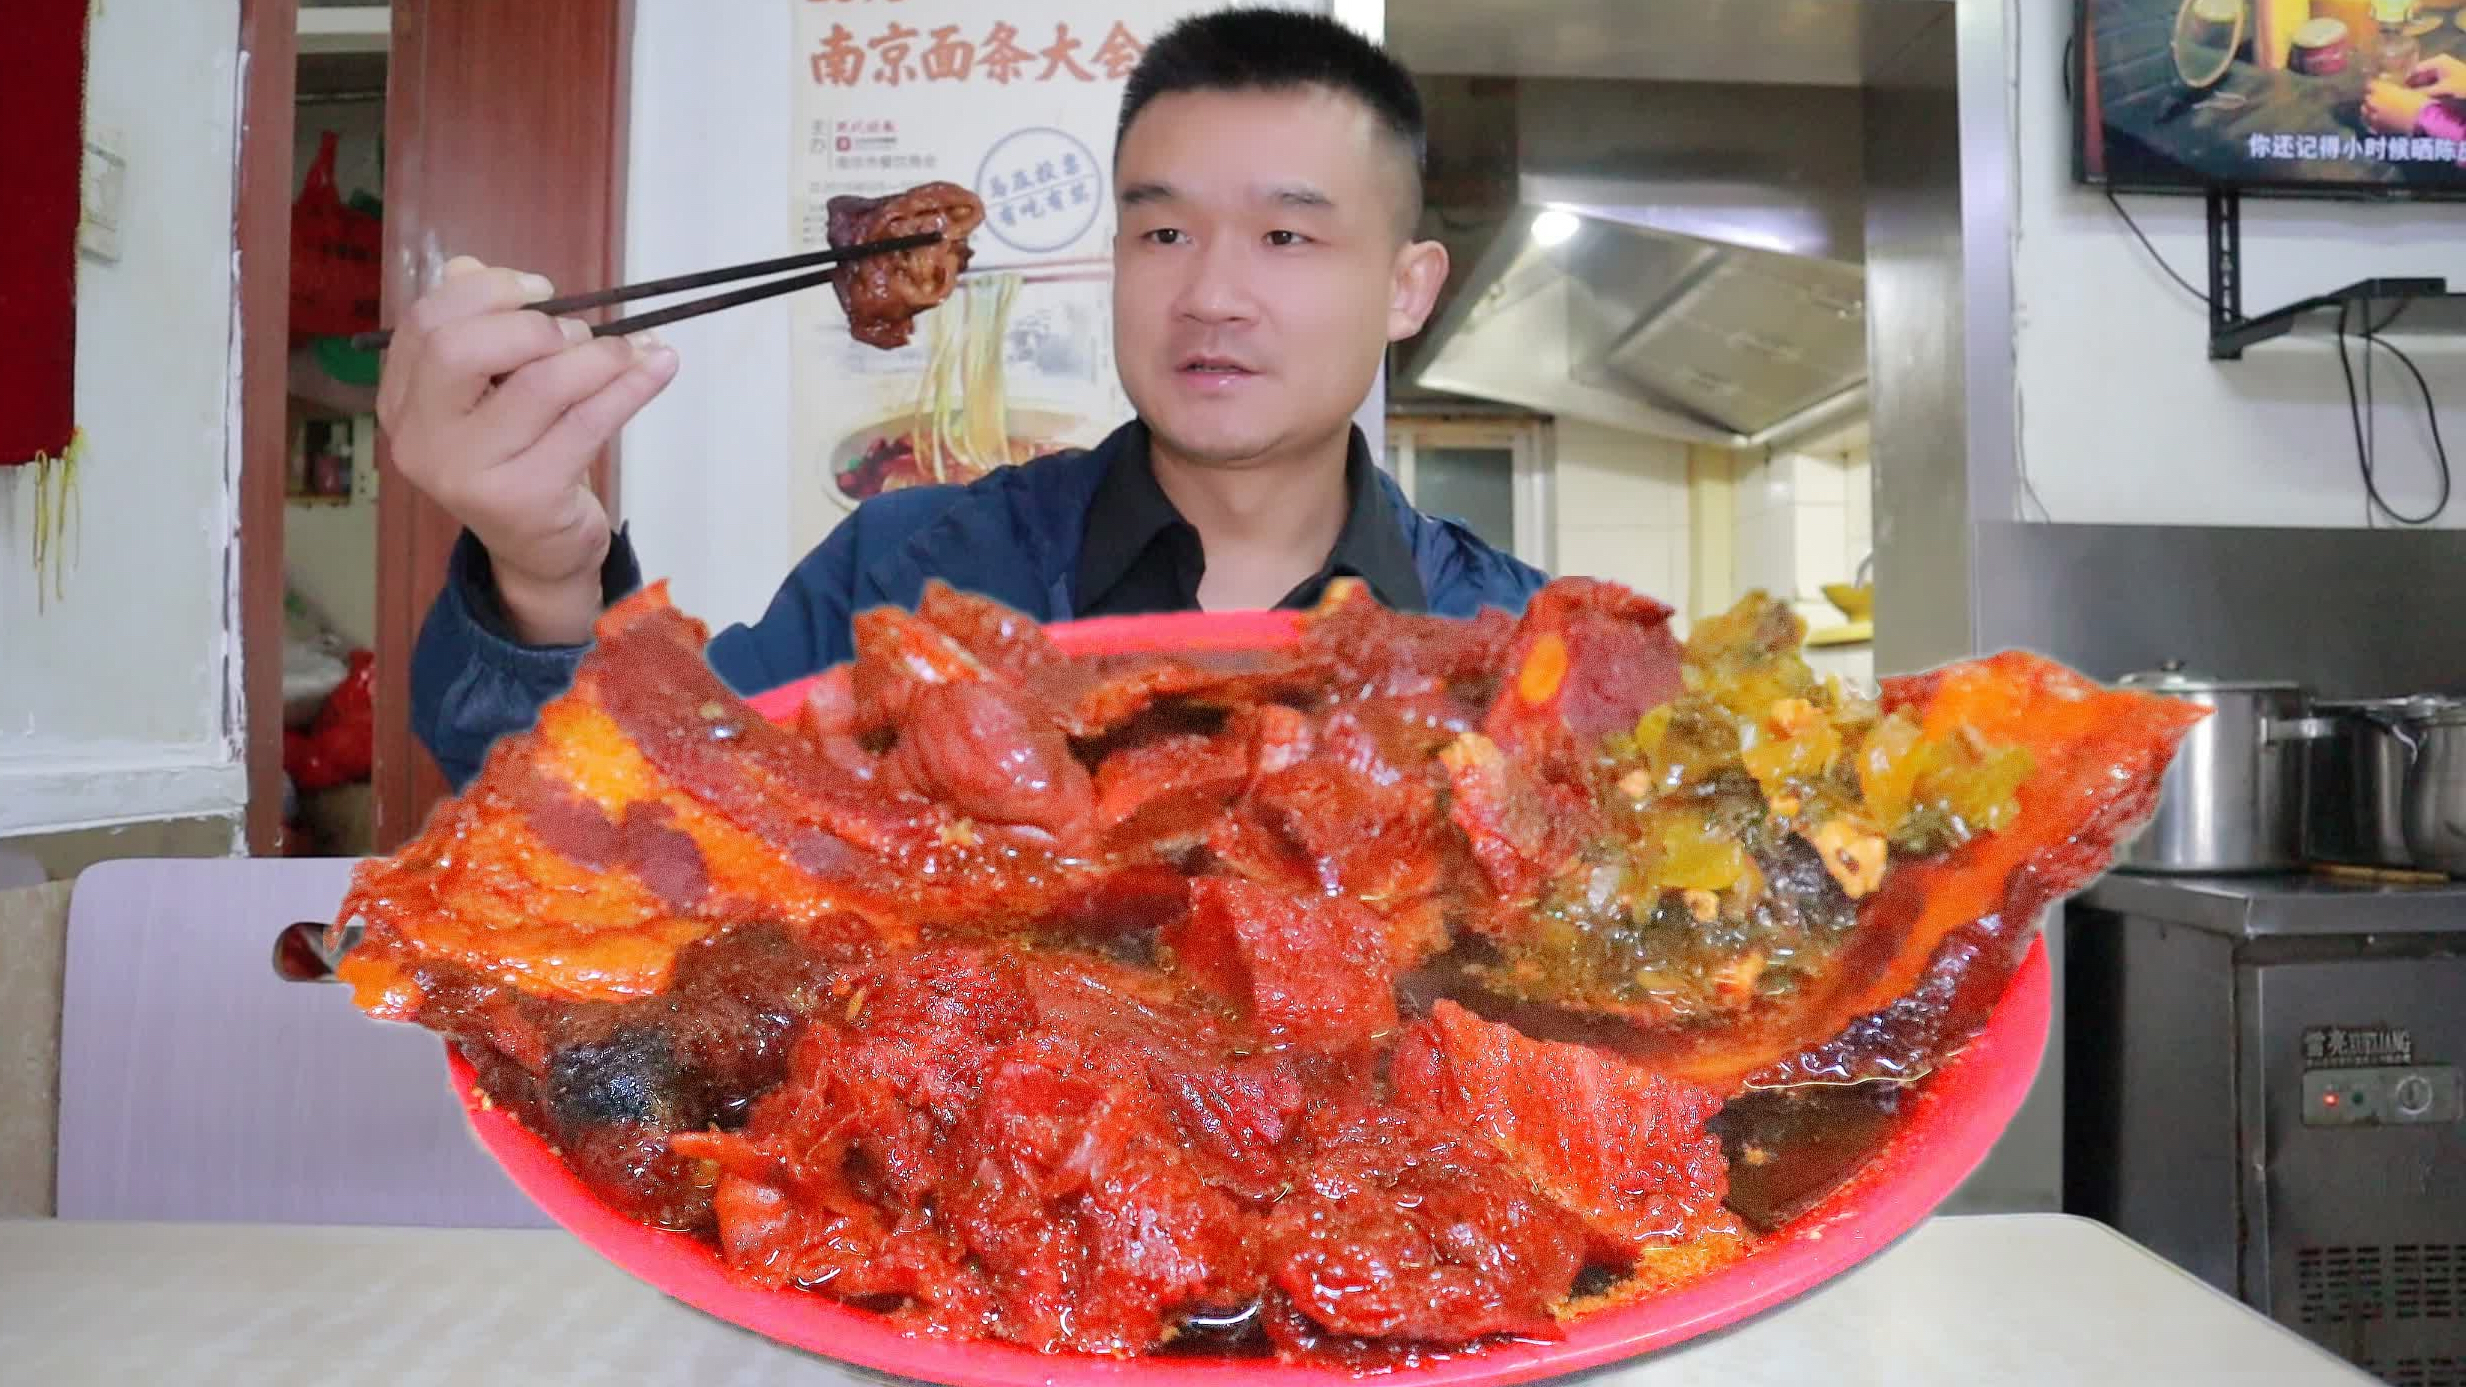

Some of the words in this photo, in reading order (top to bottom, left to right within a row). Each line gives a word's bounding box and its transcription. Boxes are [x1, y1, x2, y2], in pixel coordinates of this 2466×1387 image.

[810, 20, 1149, 86] 南京面条大会
